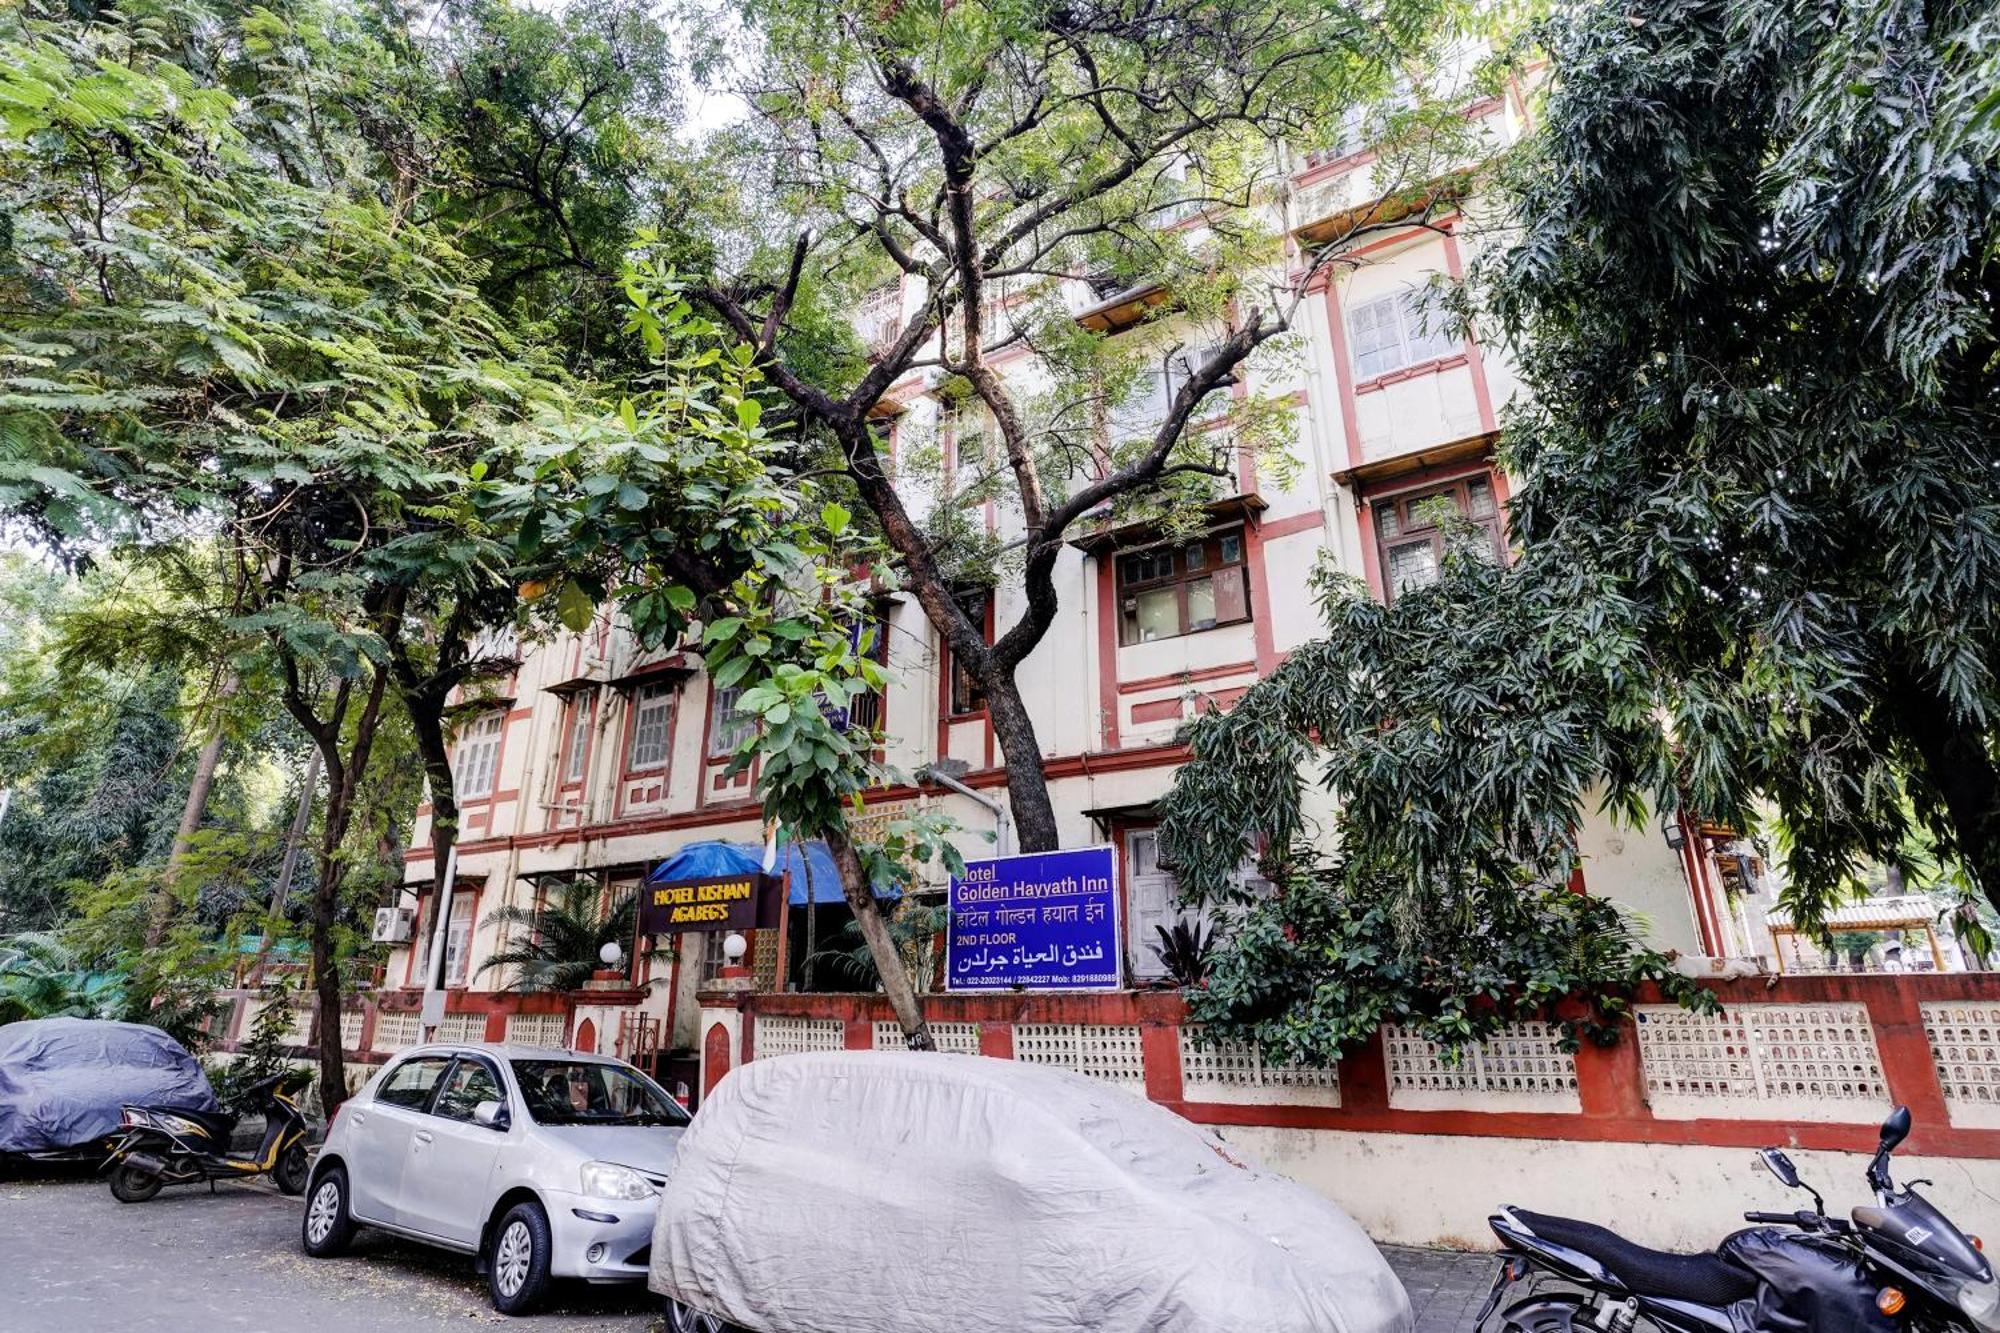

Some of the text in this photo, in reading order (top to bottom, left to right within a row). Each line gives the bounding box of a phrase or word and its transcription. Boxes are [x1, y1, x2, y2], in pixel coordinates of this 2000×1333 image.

[654, 882, 751, 906] HOTEL KISHAN
[957, 875, 1108, 902] Golden Hayyath Inn
[995, 903, 1037, 926] गोल्डन
[1042, 904, 1079, 925] हयात
[1084, 897, 1106, 924] ईन
[956, 932, 1017, 946] 2ND FLOOR
[957, 940, 1104, 973] فندق الحياة جولدن
